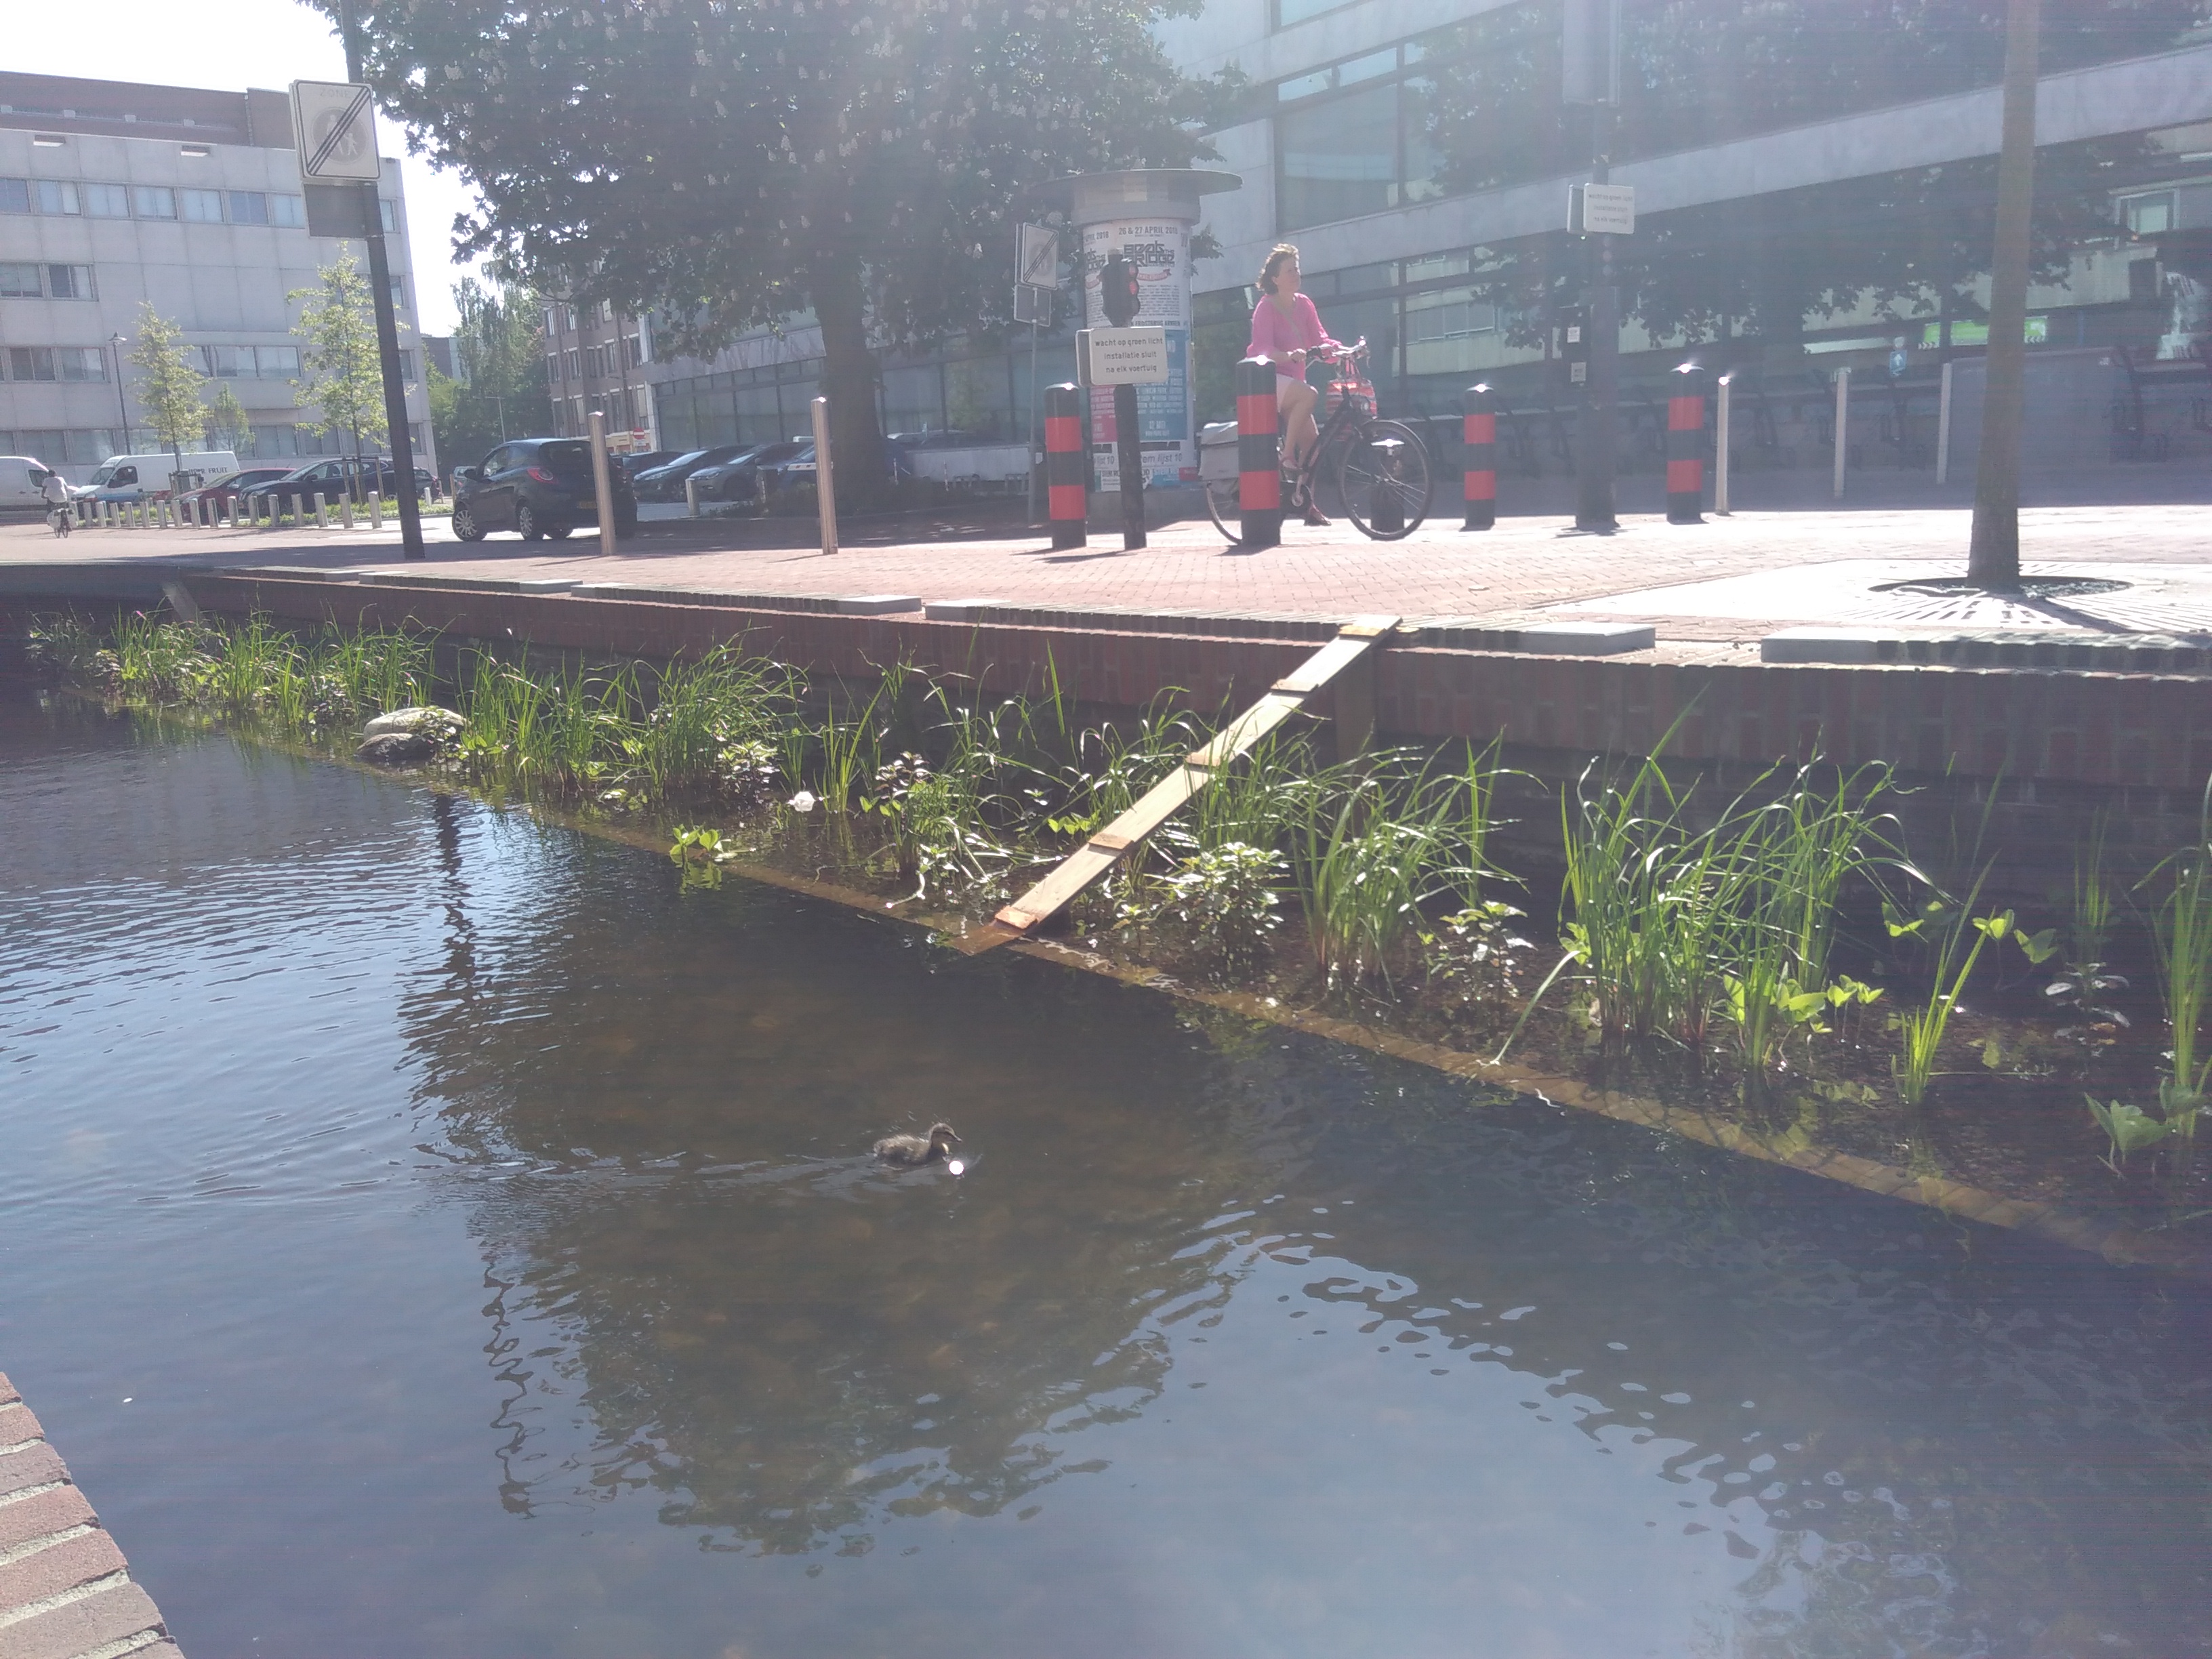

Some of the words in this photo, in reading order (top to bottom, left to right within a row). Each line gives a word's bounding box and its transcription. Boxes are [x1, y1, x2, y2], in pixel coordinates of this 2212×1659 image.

[319, 87, 352, 98] ZONE
[1118, 227, 1126, 235] 26
[1145, 226, 1164, 234] APRIL
[1096, 231, 1109, 239] 2018
[1128, 339, 1147, 347] groen
[1104, 352, 1139, 360] installatie
[1129, 365, 1157, 373] voertuig
[1107, 455, 1115, 464] 10
[1174, 453, 1183, 462] 10
